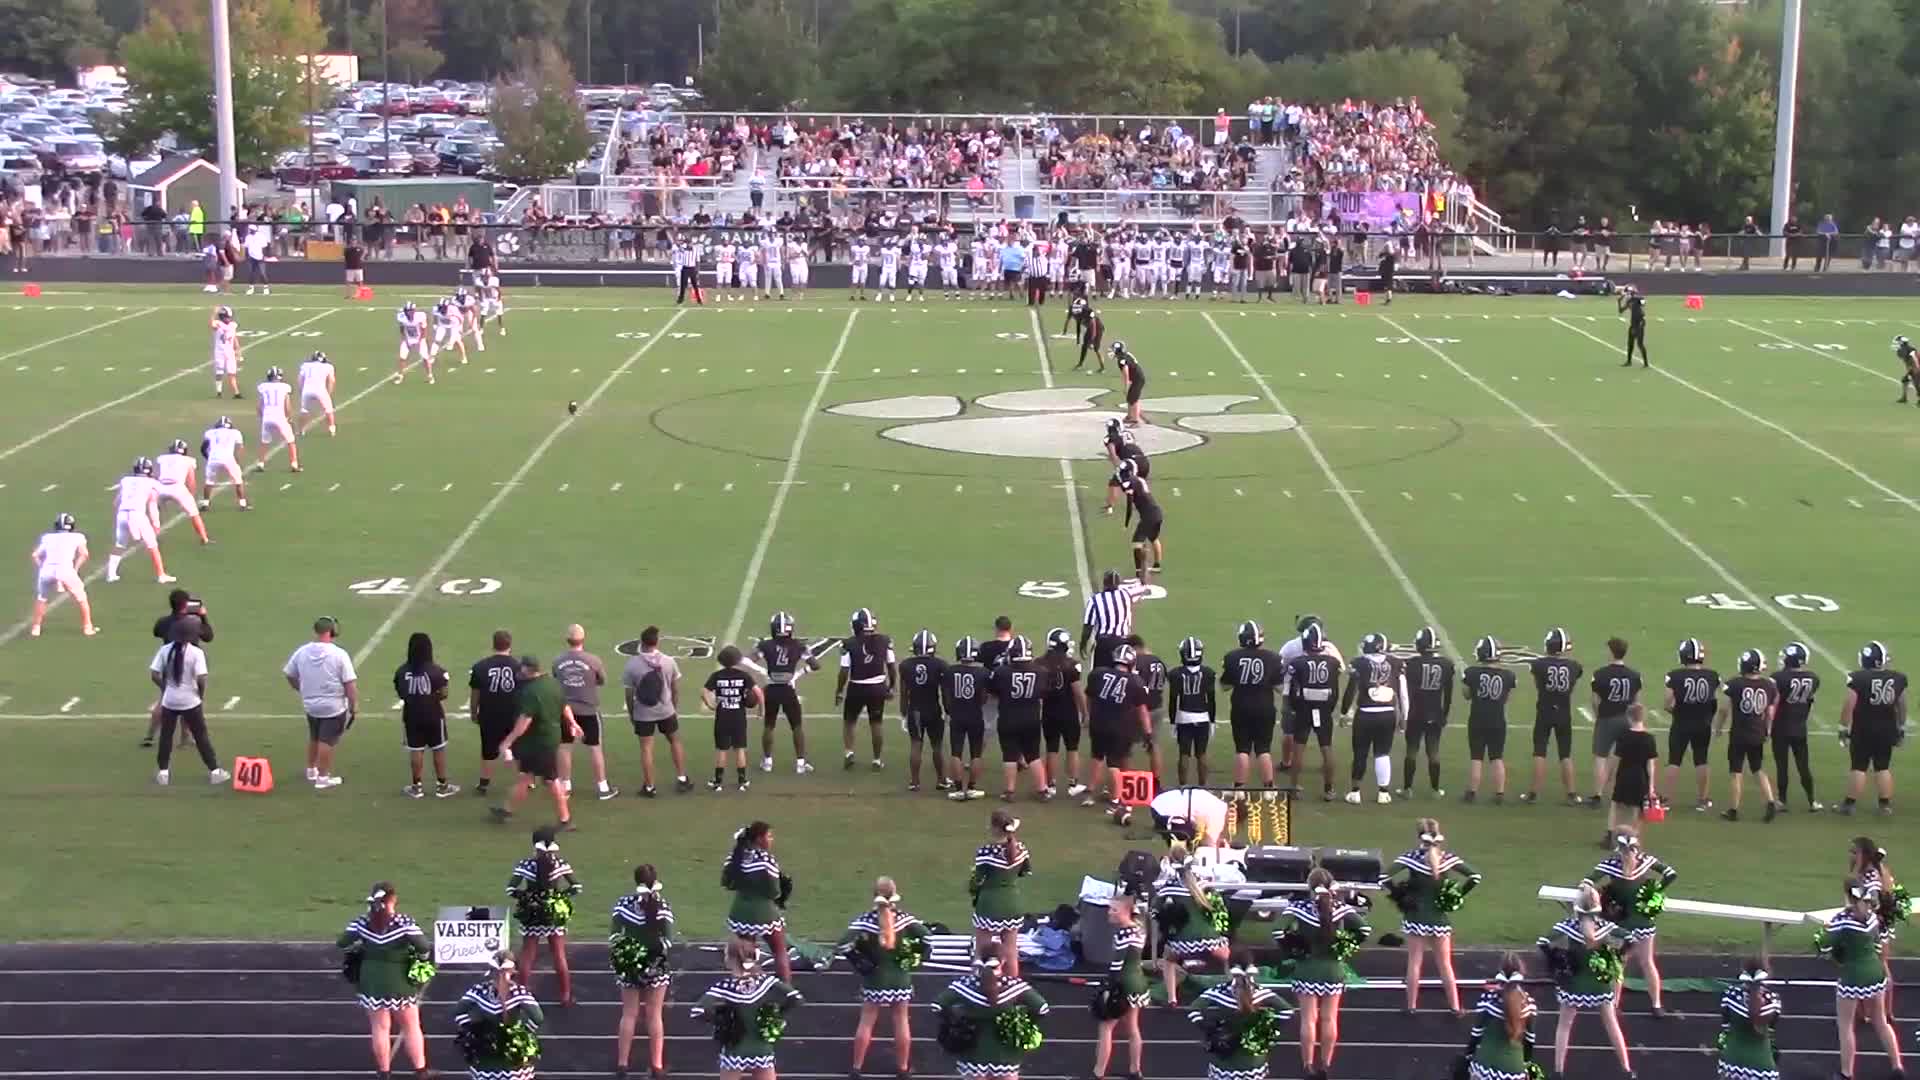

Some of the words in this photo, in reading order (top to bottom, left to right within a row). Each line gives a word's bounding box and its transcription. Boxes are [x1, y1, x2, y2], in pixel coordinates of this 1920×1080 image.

[348, 577, 503, 595] 40
[488, 666, 515, 693] 78
[1239, 657, 1264, 685] 79
[1307, 660, 1329, 684] 16
[1420, 663, 1442, 690] 12
[1545, 666, 1569, 692] 33
[954, 673, 975, 699] 18
[1011, 672, 1036, 699] 57
[1100, 673, 1127, 704] 74
[1477, 673, 1503, 700] 30
[1608, 678, 1631, 702] 21
[1684, 678, 1709, 704] 20
[1787, 678, 1813, 704] 27
[1869, 679, 1895, 705] 56
[1740, 687, 1767, 714] 80
[238, 762, 262, 786] 40
[1121, 776, 1149, 800] 50
[436, 922, 503, 937] VARSITY
[438, 944, 484, 961] Cheer
